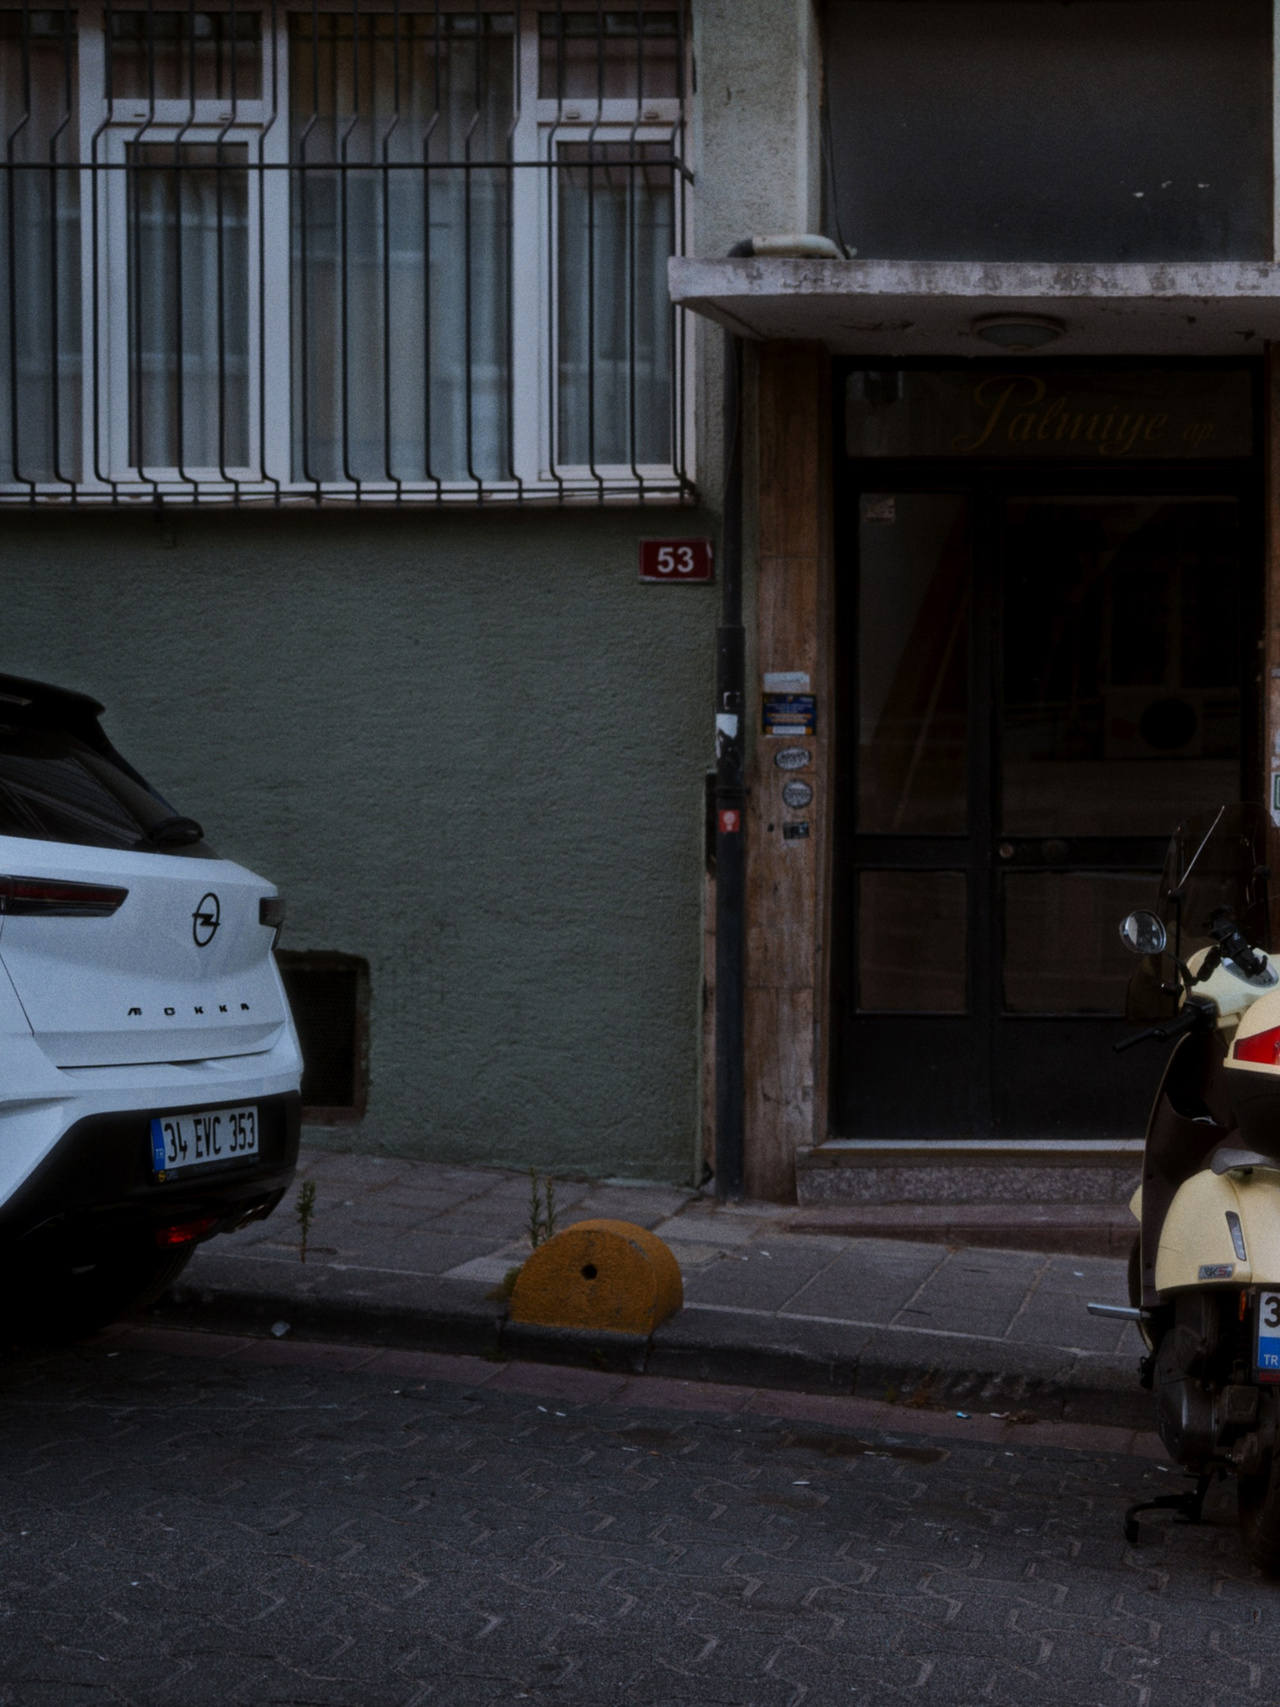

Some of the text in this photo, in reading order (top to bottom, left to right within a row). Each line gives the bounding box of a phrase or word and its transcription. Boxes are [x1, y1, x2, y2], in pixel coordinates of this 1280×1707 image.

[951, 374, 1169, 456] Palmiye
[657, 546, 694, 573] 53
[127, 1002, 250, 1016] MOKKA
[164, 1112, 255, 1162] 34 EVC 353
[155, 1148, 165, 1160] TR
[1263, 1354, 1279, 1366] TR
